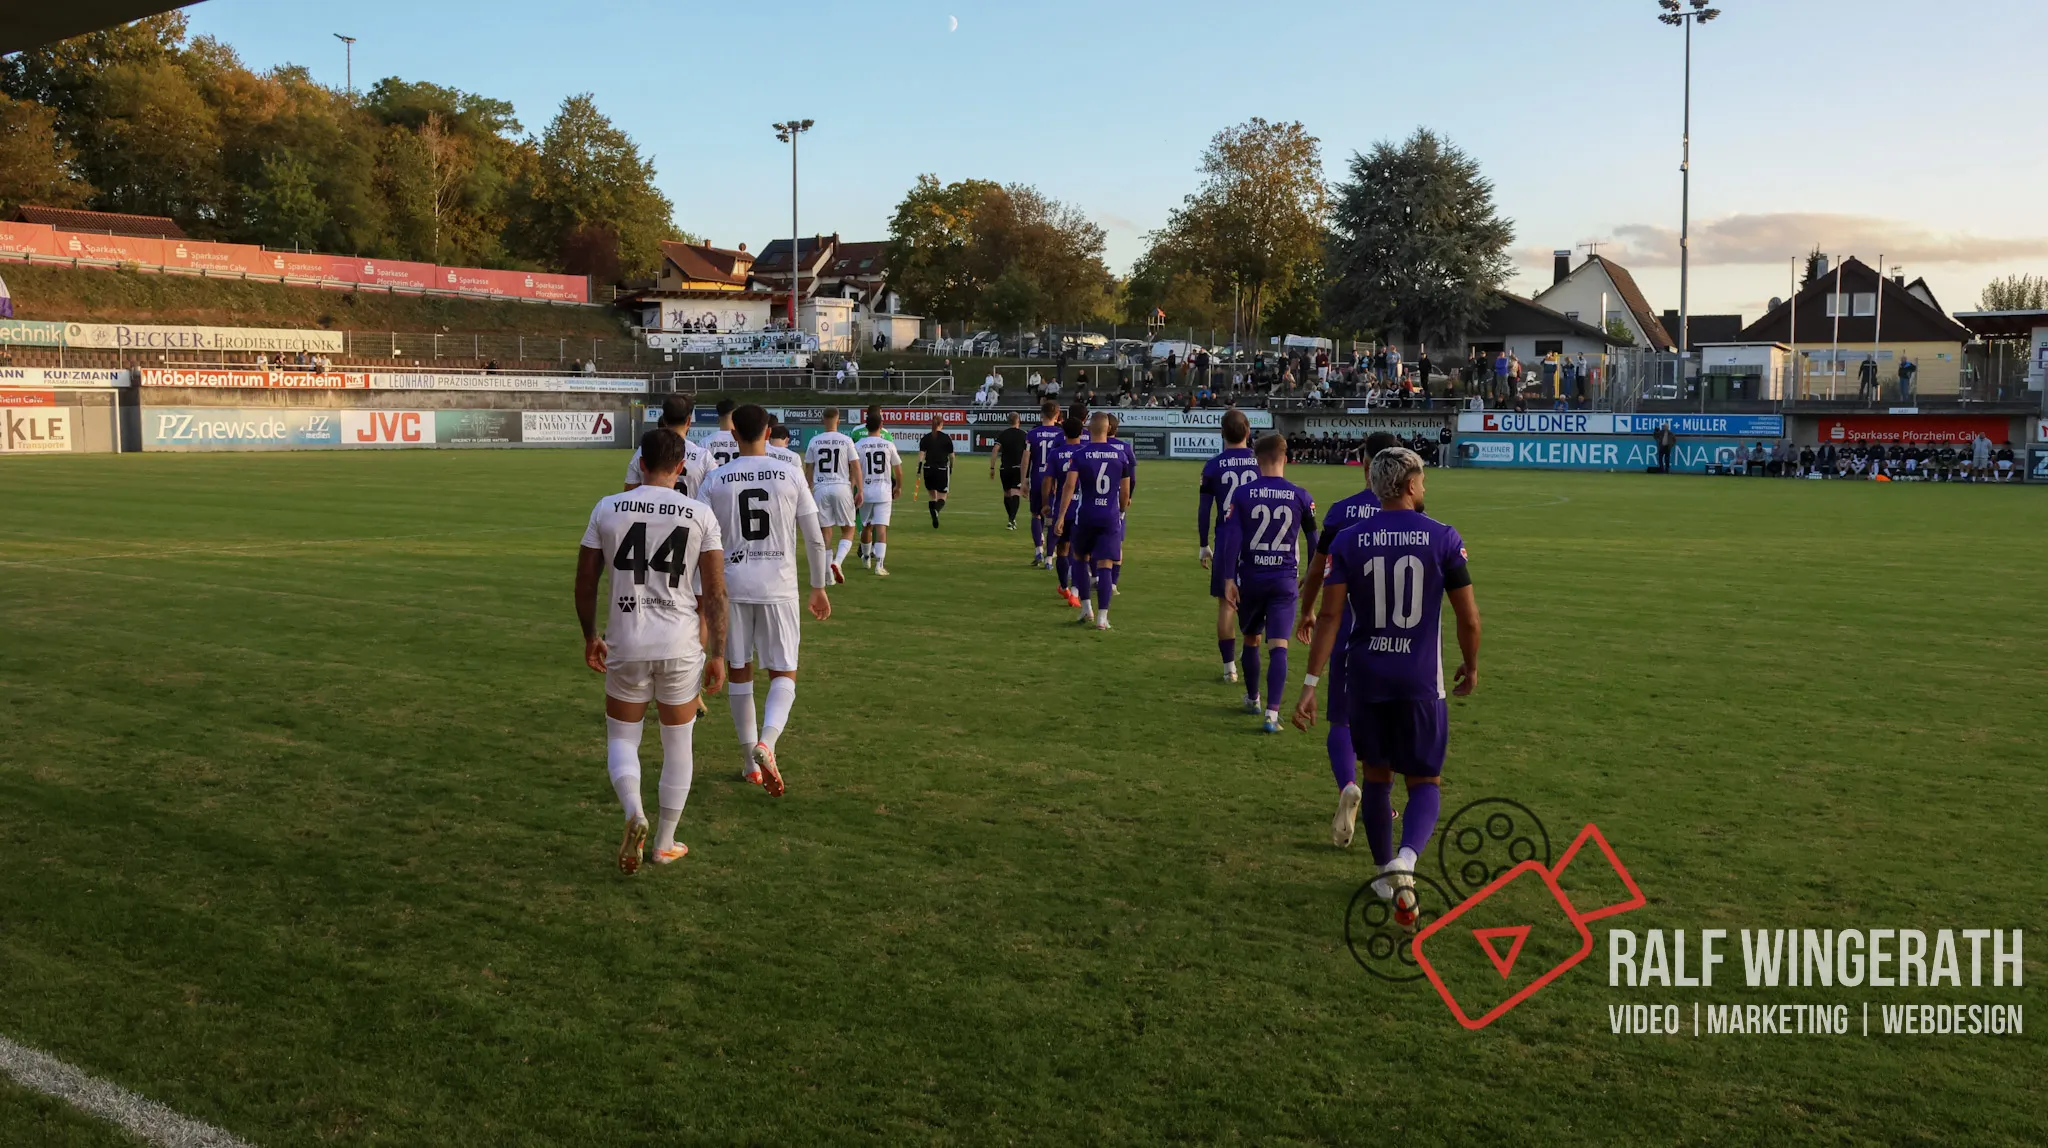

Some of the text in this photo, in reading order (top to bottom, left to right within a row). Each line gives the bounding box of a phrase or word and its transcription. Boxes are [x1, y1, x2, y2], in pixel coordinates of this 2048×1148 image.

[85, 244, 126, 255] Sparkasse
[191, 252, 229, 262] Sparkasse
[191, 262, 228, 271] Pforzheim
[288, 263, 322, 272] Sparkasse
[377, 269, 408, 278] Sparkasse
[376, 278, 408, 287] Pforzheim
[459, 277, 489, 286] Sparkasse
[535, 282, 564, 290] Sparkasse
[535, 290, 564, 298] Pforzheim
[116, 326, 204, 348] BECKER
[43, 370, 118, 380] KUNZMANN
[147, 370, 263, 387] Möbelzentrum
[269, 372, 342, 388] Pforzheim
[389, 374, 538, 388] LEONHARD PRÄZISIONSTEILE GMBH
[539, 413, 594, 423] SVEN STÜTZ
[784, 409, 807, 418] Krauss
[863, 409, 902, 420] EKTRO
[978, 412, 1041, 422] AUTOHA WERN
[156, 414, 287, 439] PZ-news.de
[307, 415, 330, 431] PZ
[357, 412, 421, 442] JVC
[539, 422, 587, 430] IMMO TAX
[1331, 417, 1386, 428] CONSILIA
[1390, 417, 1442, 428] Karlsruhe
[1501, 415, 1587, 432] GÜLDNER
[1683, 418, 1727, 431] MÜLLER
[1174, 437, 1220, 447] HERZOG
[1848, 430, 1900, 442] Sparkasse
[1902, 430, 1955, 441] Pforzheim
[818, 448, 840, 473] 21
[1093, 451, 1118, 459] NÖTTINGEN
[1519, 442, 1710, 467] KLEINER ARNA
[865, 451, 886, 475] 19
[1219, 459, 1227, 468] FC
[720, 470, 786, 485] YOUNG BOYS
[1095, 462, 1110, 495] 6
[1249, 486, 1295, 500] FC NÖTTINGEN
[613, 501, 694, 519] YOUNG BOYS
[738, 488, 770, 541] 6
[1346, 505, 1357, 518] FC
[1249, 504, 1293, 552] 22
[1358, 529, 1430, 547] FC NÖTTINGEN
[613, 521, 690, 589] 44
[1254, 555, 1284, 566] RABOLD
[1363, 554, 1425, 629] 10
